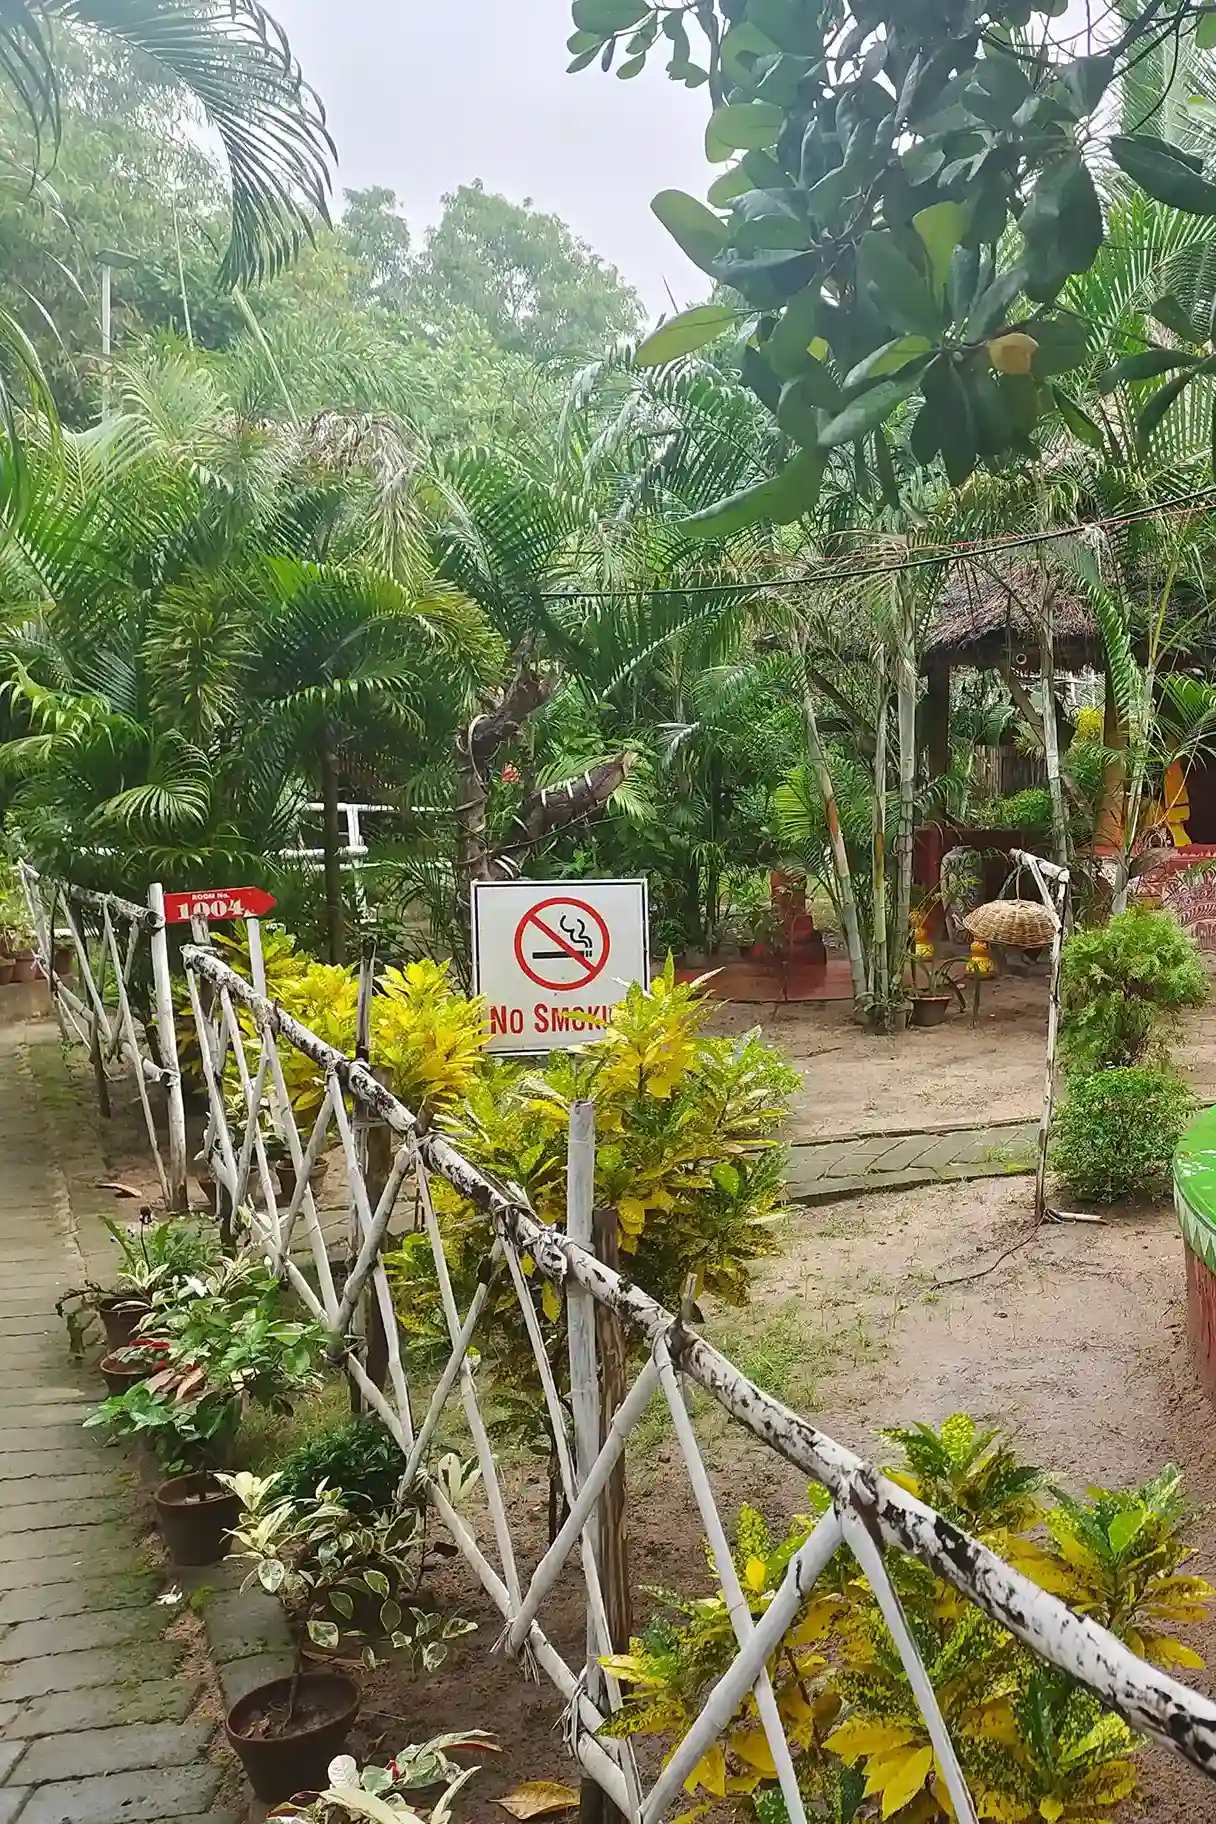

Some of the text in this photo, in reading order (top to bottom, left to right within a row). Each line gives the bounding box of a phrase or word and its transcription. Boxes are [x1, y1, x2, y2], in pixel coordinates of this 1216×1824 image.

[192, 893, 215, 901] ROOM
[177, 898, 244, 920] 1004
[534, 1003, 613, 1033] SMOKI
